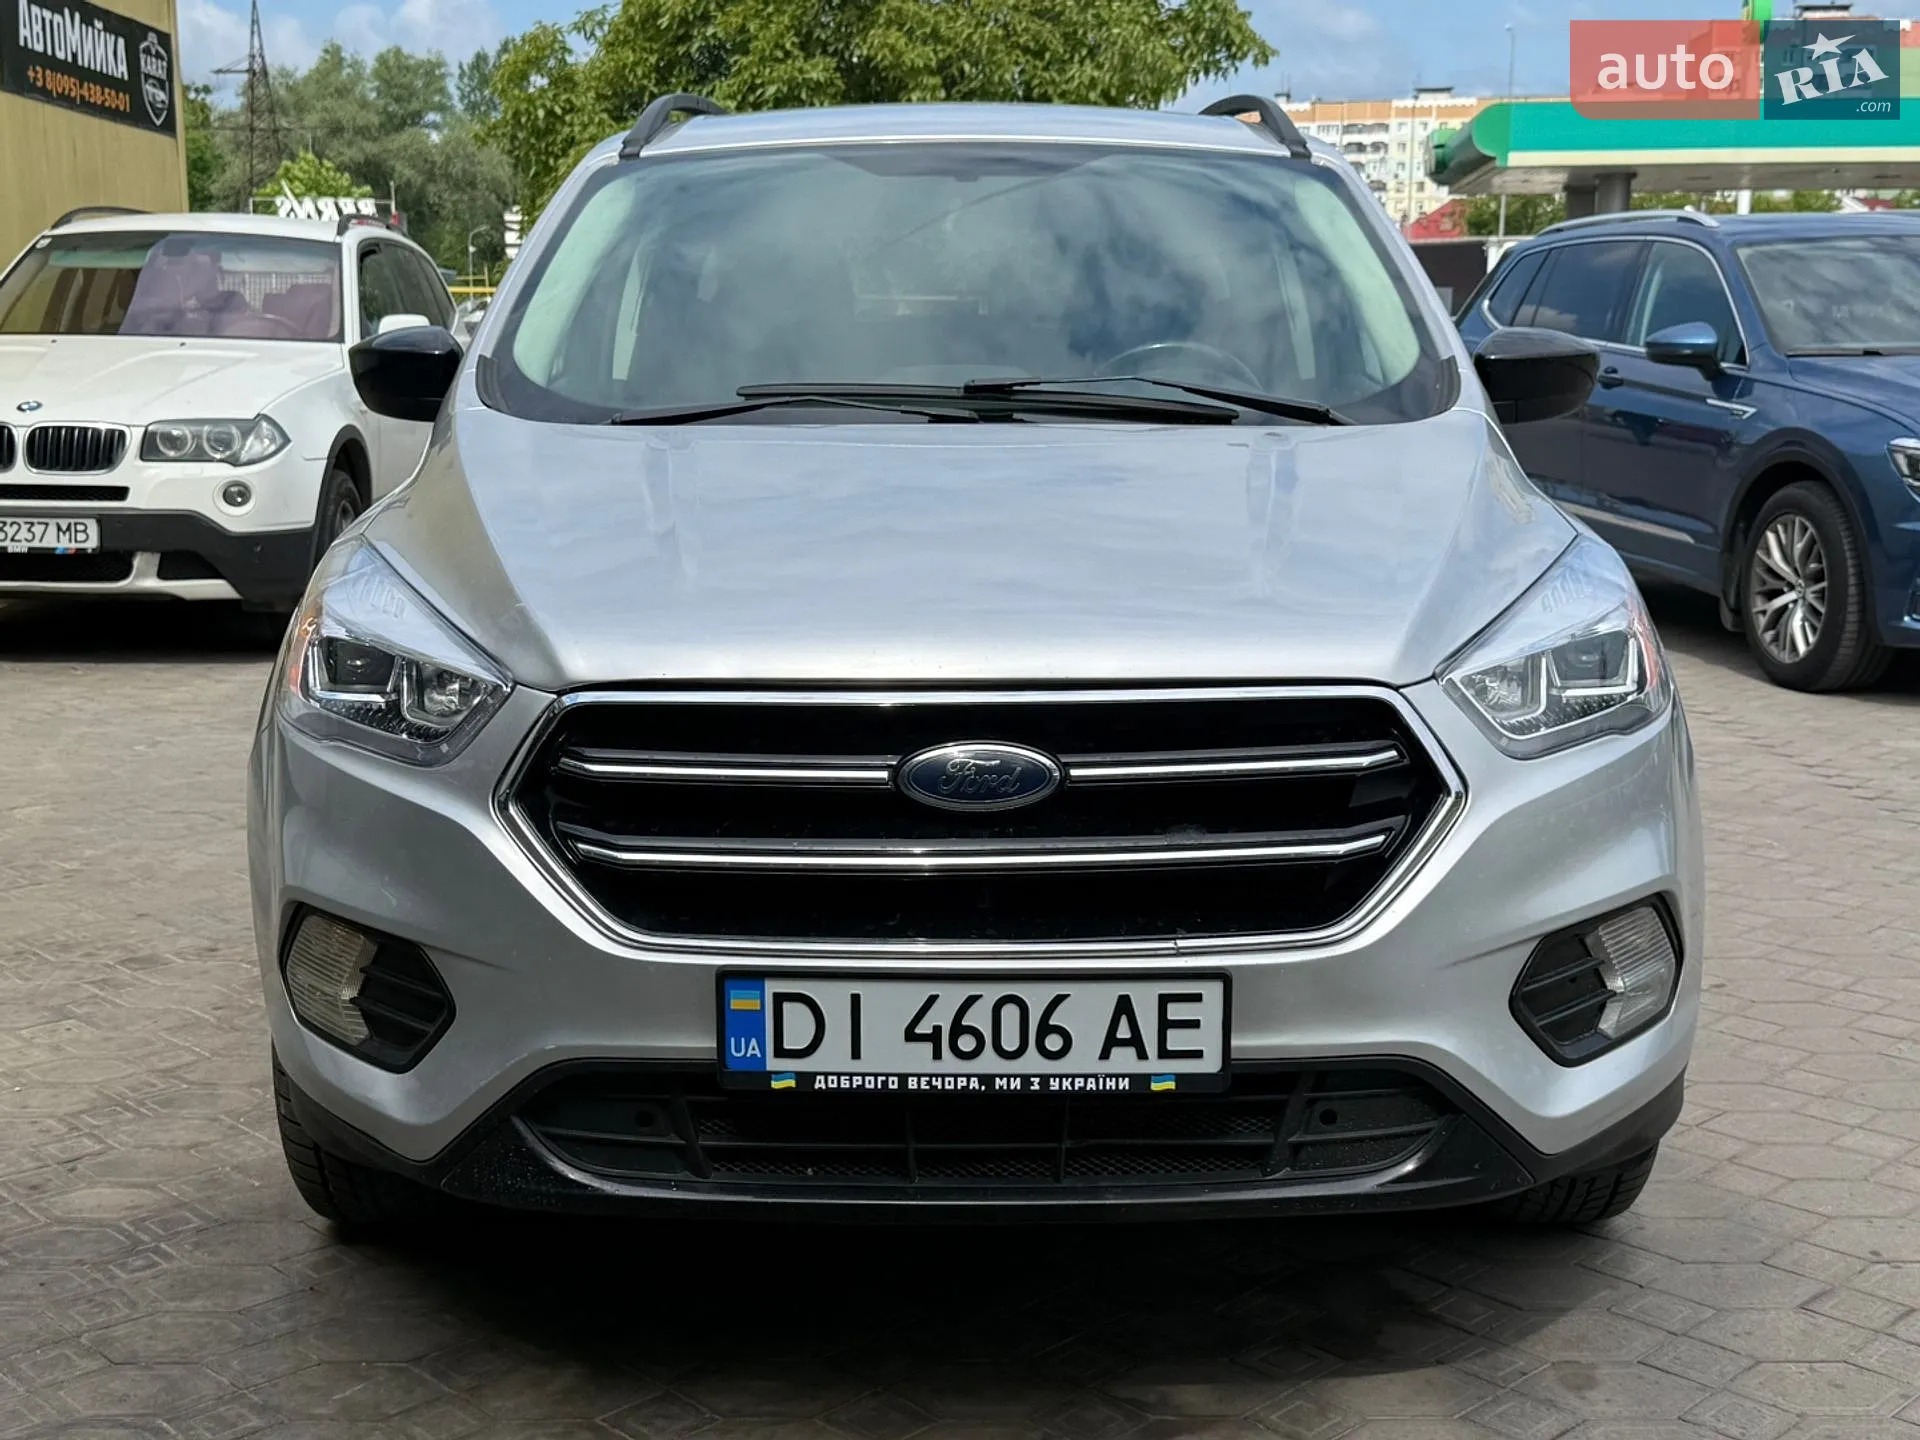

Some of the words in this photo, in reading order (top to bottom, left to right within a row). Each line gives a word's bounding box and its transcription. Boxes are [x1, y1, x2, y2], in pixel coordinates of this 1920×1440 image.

[0, 521, 49, 543] 3237
[56, 521, 89, 543] MB
[937, 758, 1022, 793] Ford
[772, 991, 862, 1060] DI
[904, 993, 1073, 1060] 4606
[1098, 993, 1204, 1060] AE
[730, 1038, 761, 1058] UA
[814, 1075, 899, 1090] ДОБРОГО
[907, 1076, 986, 1091] ВЕЧОРА,
[995, 1077, 1021, 1090] МИ
[1049, 1074, 1130, 1091] УКРАЇНИ
